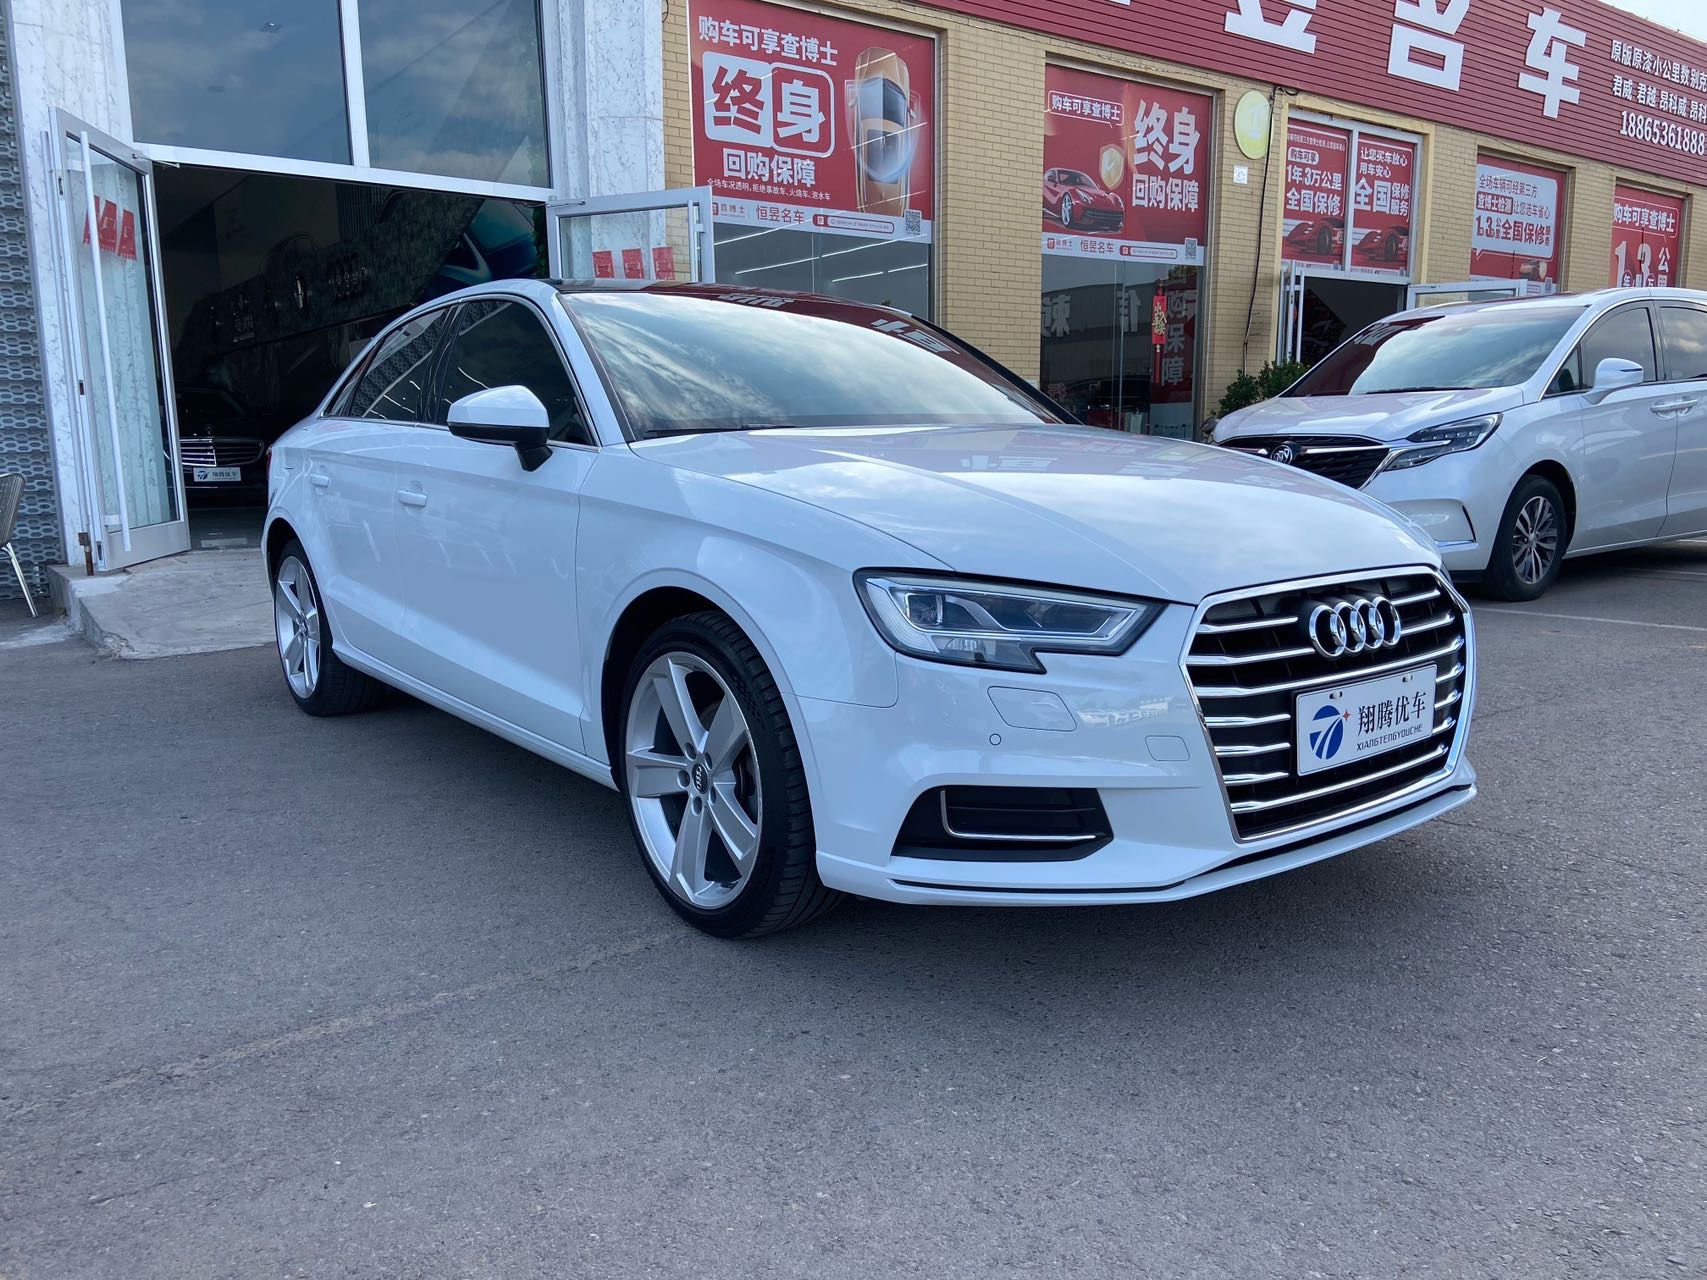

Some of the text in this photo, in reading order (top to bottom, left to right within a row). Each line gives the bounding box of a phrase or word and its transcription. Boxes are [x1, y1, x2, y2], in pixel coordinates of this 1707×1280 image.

[698, 15, 838, 67] 购车可享查博士
[1611, 39, 1690, 87] 原版原漆小公里数
[711, 64, 825, 144] 终身
[1612, 75, 1633, 101] 君威
[1637, 83, 1657, 107] 君越
[1052, 95, 1121, 121] 购车可享查博士
[1133, 99, 1201, 175] 终身
[1619, 110, 1706, 156] 18865361888
[722, 147, 816, 188] 回购保障
[1290, 149, 1317, 163] 购车可享
[1359, 162, 1392, 179] 用车安心
[1360, 146, 1408, 167] 让您买车放心
[1132, 174, 1200, 213] 回购保障
[1286, 187, 1341, 216] 全国保修
[1354, 177, 1391, 215] 全国
[1477, 193, 1513, 214] 查博士检测
[756, 204, 805, 225] 恒昱名车
[1613, 202, 1675, 233] 购车可享查博士
[1080, 240, 1115, 255] 恒昱名车
[1358, 691, 1427, 736] 翔腾优车
[1356, 724, 1424, 752] XIANGTENGYOUCHE
